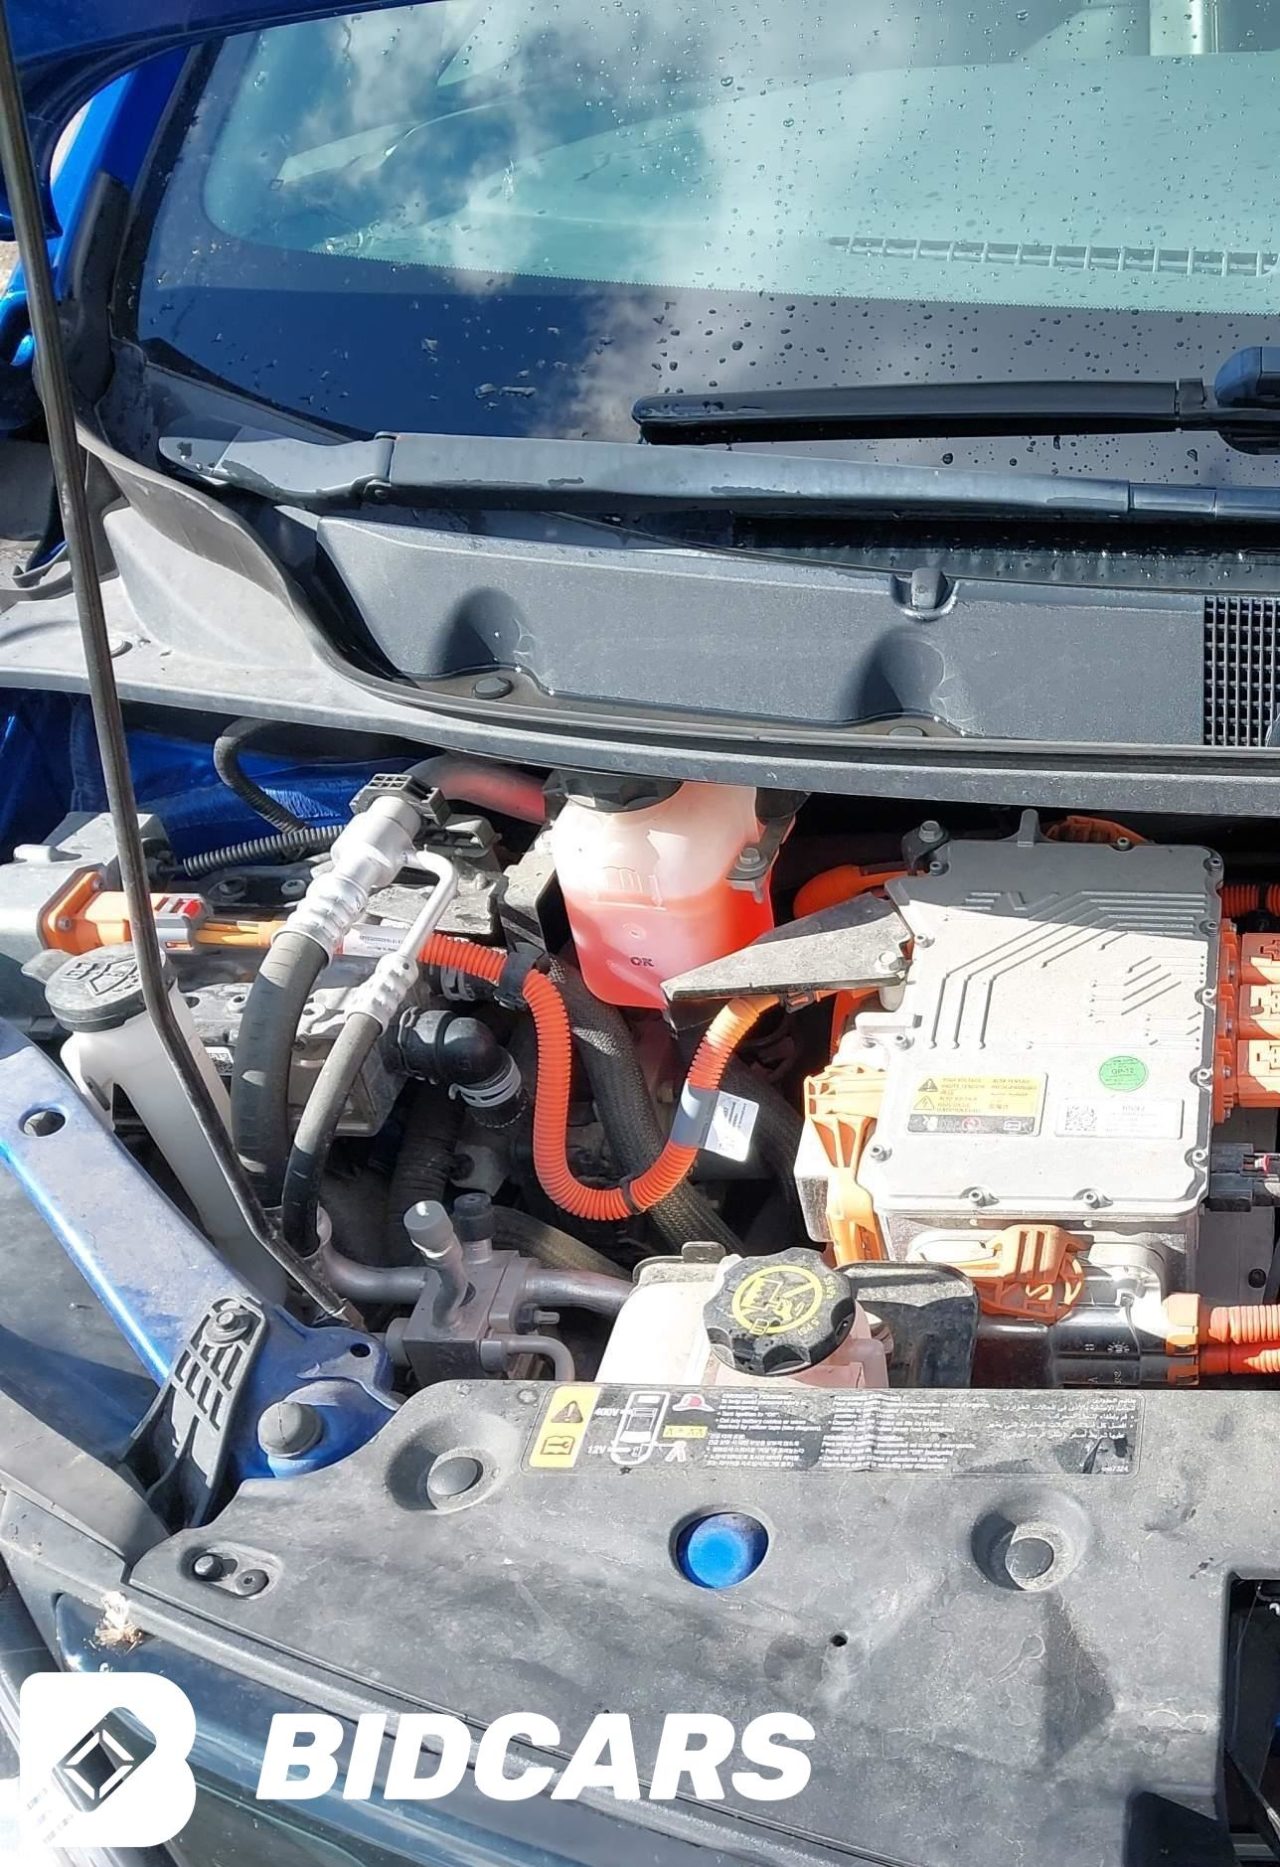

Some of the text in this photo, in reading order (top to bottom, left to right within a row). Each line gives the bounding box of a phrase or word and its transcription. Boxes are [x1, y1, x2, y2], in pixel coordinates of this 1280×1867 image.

[630, 956, 655, 968] OK
[594, 1408, 620, 1417] 400V
[587, 1446, 607, 1454] 12V
